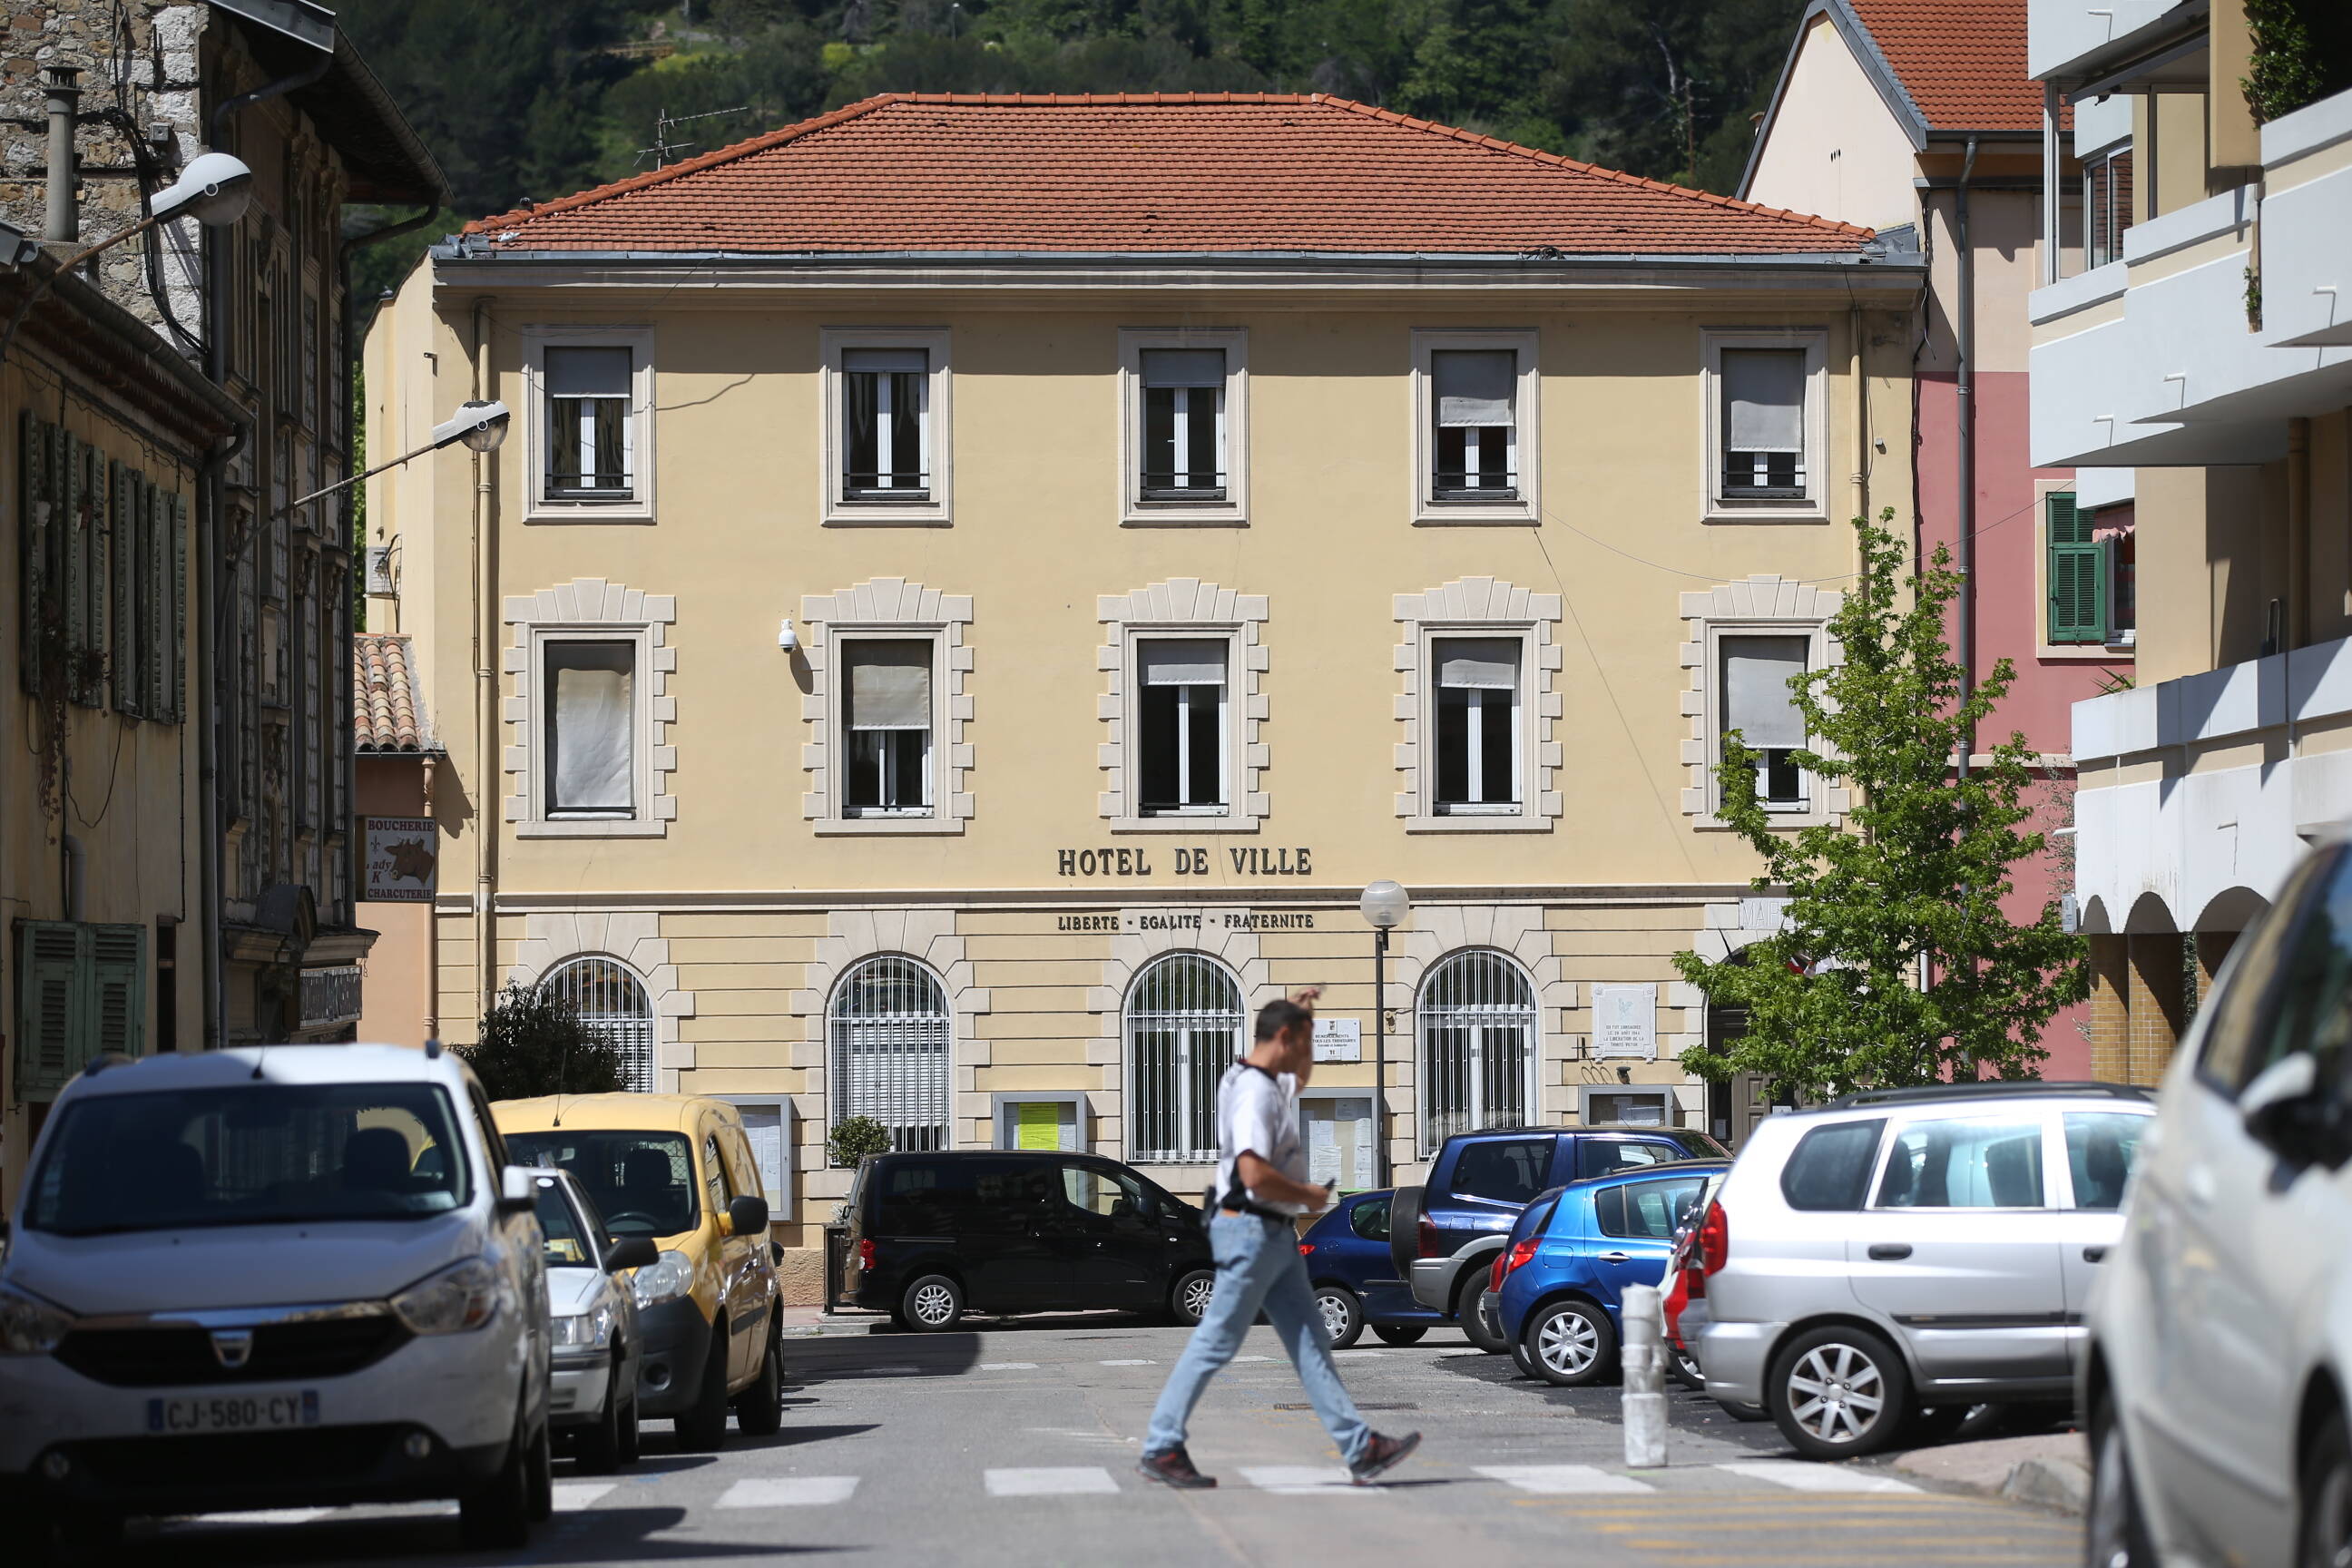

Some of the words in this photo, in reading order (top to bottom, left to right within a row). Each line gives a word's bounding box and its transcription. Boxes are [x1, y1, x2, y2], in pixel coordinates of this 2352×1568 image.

[368, 819, 435, 832] BOUCHERIE
[366, 859, 392, 872] ady
[1057, 848, 1152, 877] HOTEL
[1174, 848, 1209, 876] DE
[1230, 848, 1312, 876] VILLE
[372, 871, 382, 883] K
[368, 888, 433, 899] CHARCUTERIE
[1057, 916, 1120, 931] LIBERTE
[1140, 915, 1202, 930] EGALITE
[1223, 914, 1315, 929] FRATERNITE
